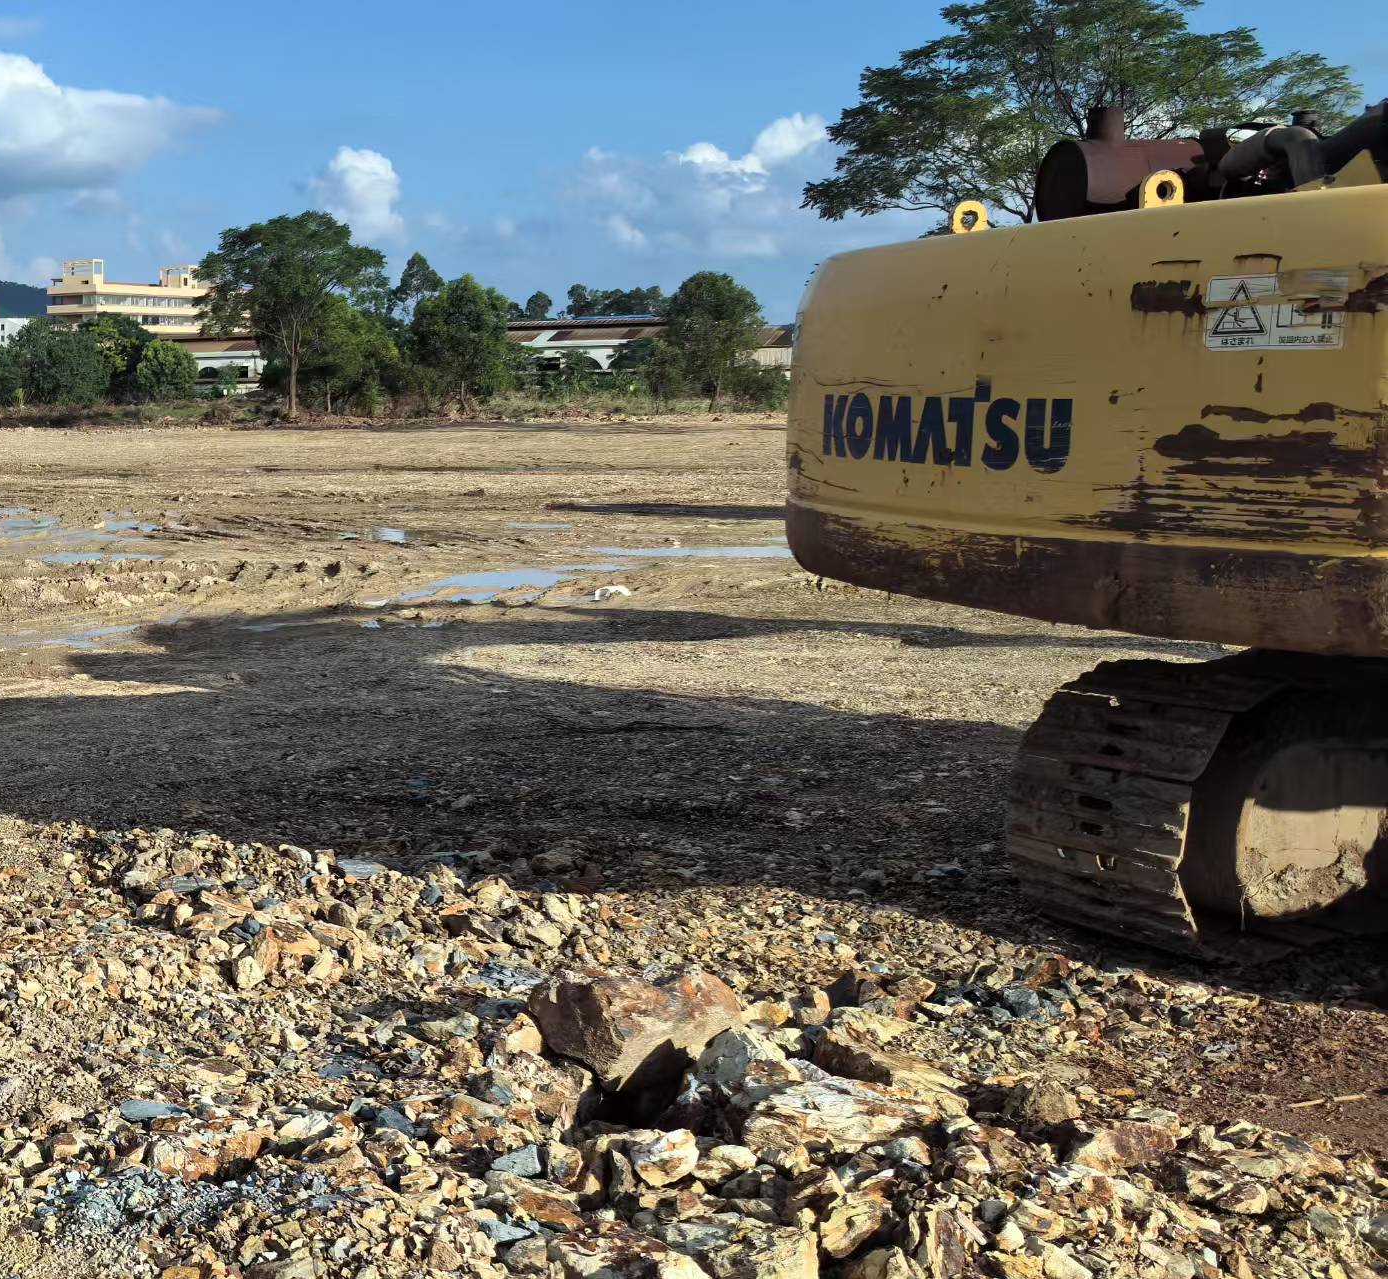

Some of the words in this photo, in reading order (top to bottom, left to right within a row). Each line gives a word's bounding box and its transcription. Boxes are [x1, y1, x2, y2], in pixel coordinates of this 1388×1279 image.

[1221, 337, 1254, 346] はさまれ
[822, 374, 1073, 475] KOMATSU
